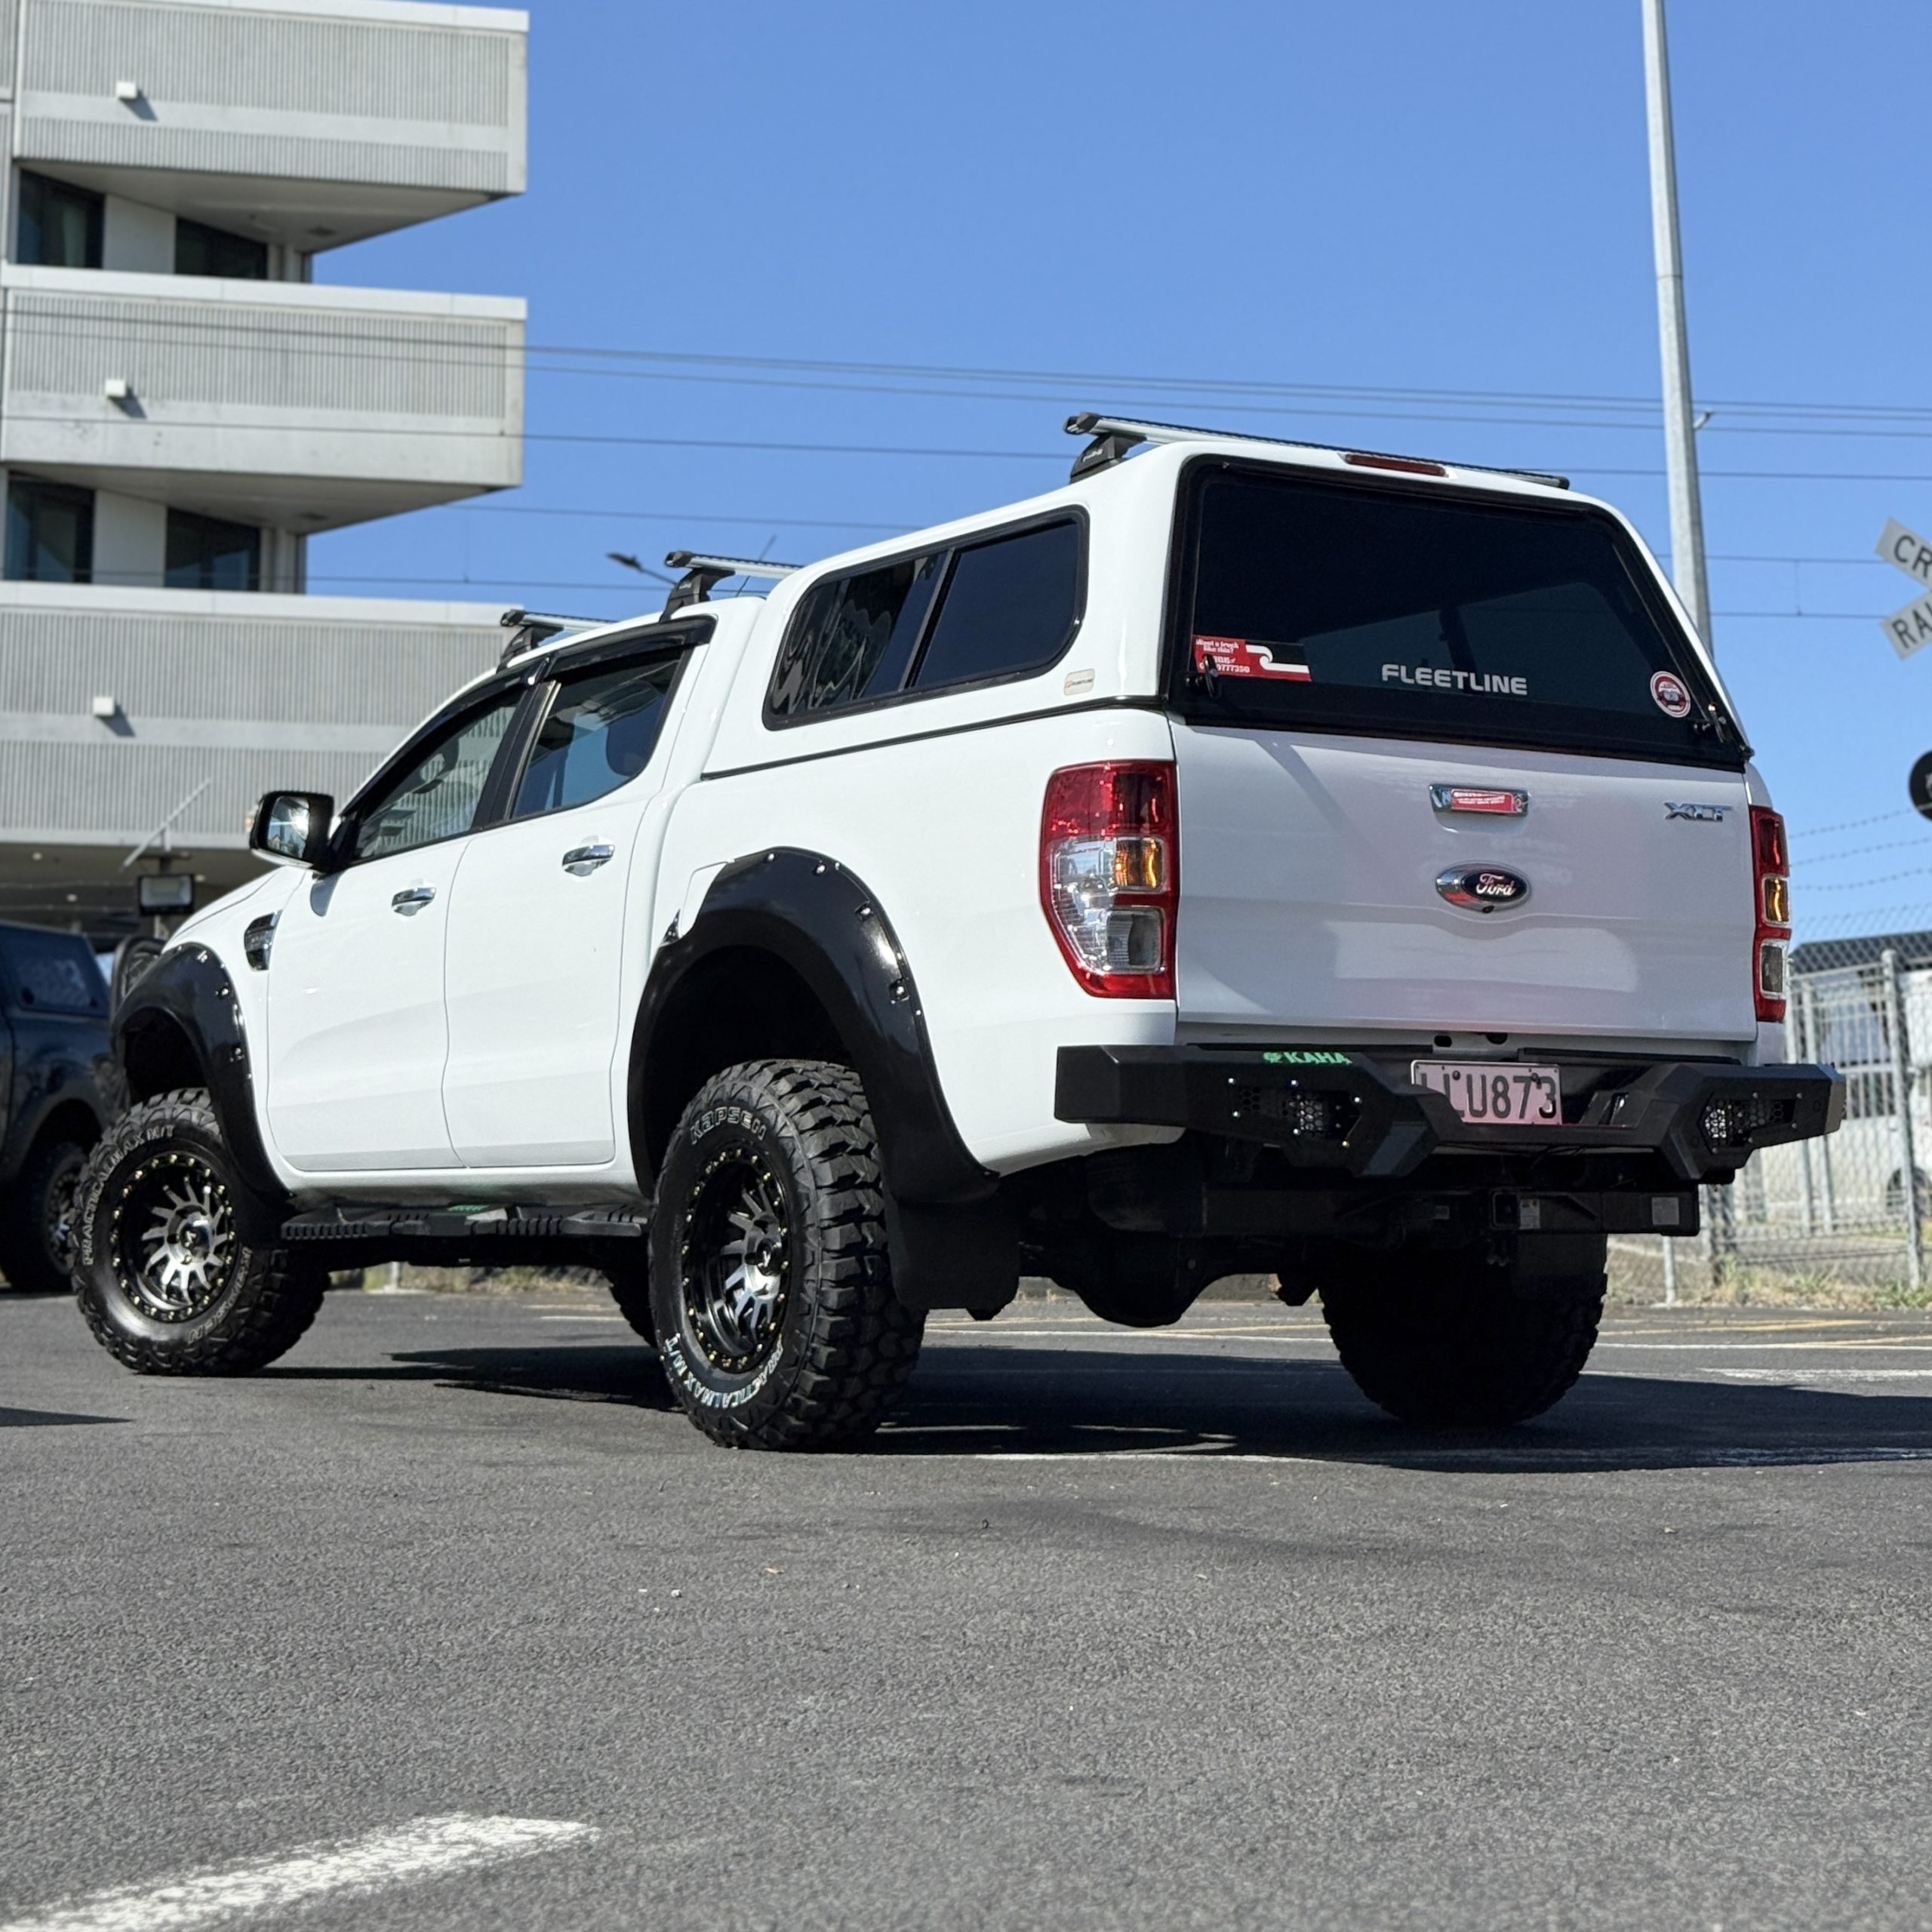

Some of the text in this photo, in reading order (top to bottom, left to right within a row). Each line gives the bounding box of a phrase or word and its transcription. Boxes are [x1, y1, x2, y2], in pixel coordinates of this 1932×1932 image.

[1381, 663, 1528, 696] FLEETLINE
[1663, 801, 1733, 823] XLT
[1475, 873, 1516, 897] Ford
[1283, 1051, 1353, 1065] KAHA
